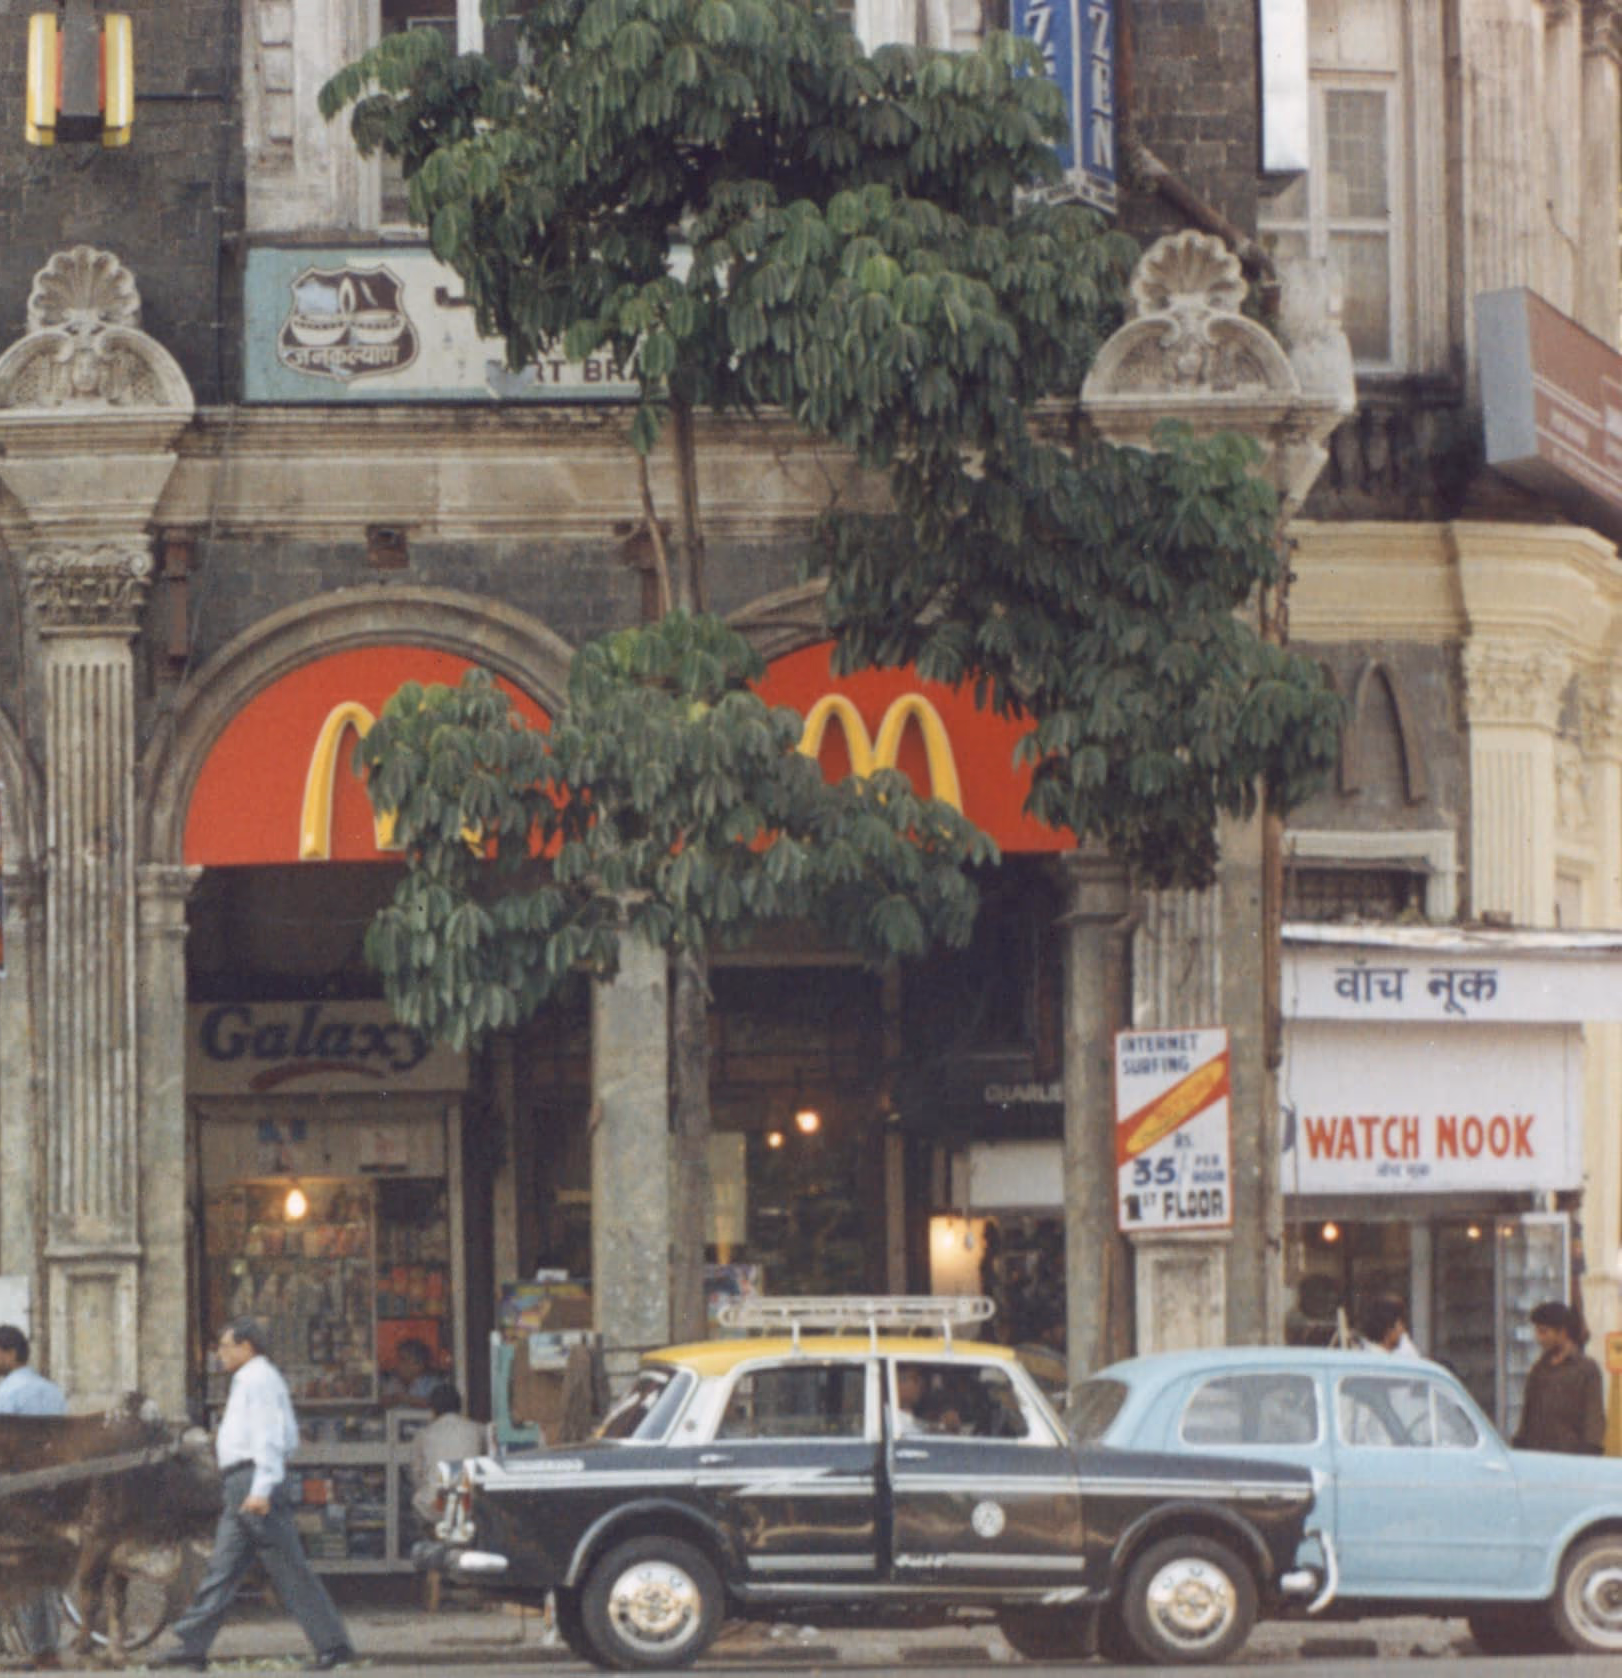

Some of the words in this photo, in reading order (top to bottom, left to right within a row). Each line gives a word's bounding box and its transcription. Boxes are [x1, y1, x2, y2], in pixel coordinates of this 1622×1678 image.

[1088, 2, 1115, 171] ZEN
[1335, 960, 1409, 1002] वॉच
[1427, 968, 1499, 1015] नूक
[200, 1004, 431, 1071] Galaxy
[1120, 1034, 1199, 1053] INTERNET
[1123, 1054, 1190, 1075] SURFING
[1304, 1115, 1419, 1160] WATCH
[1436, 1114, 1536, 1159] NOOK
[1162, 1188, 1224, 1219] FLOOR
